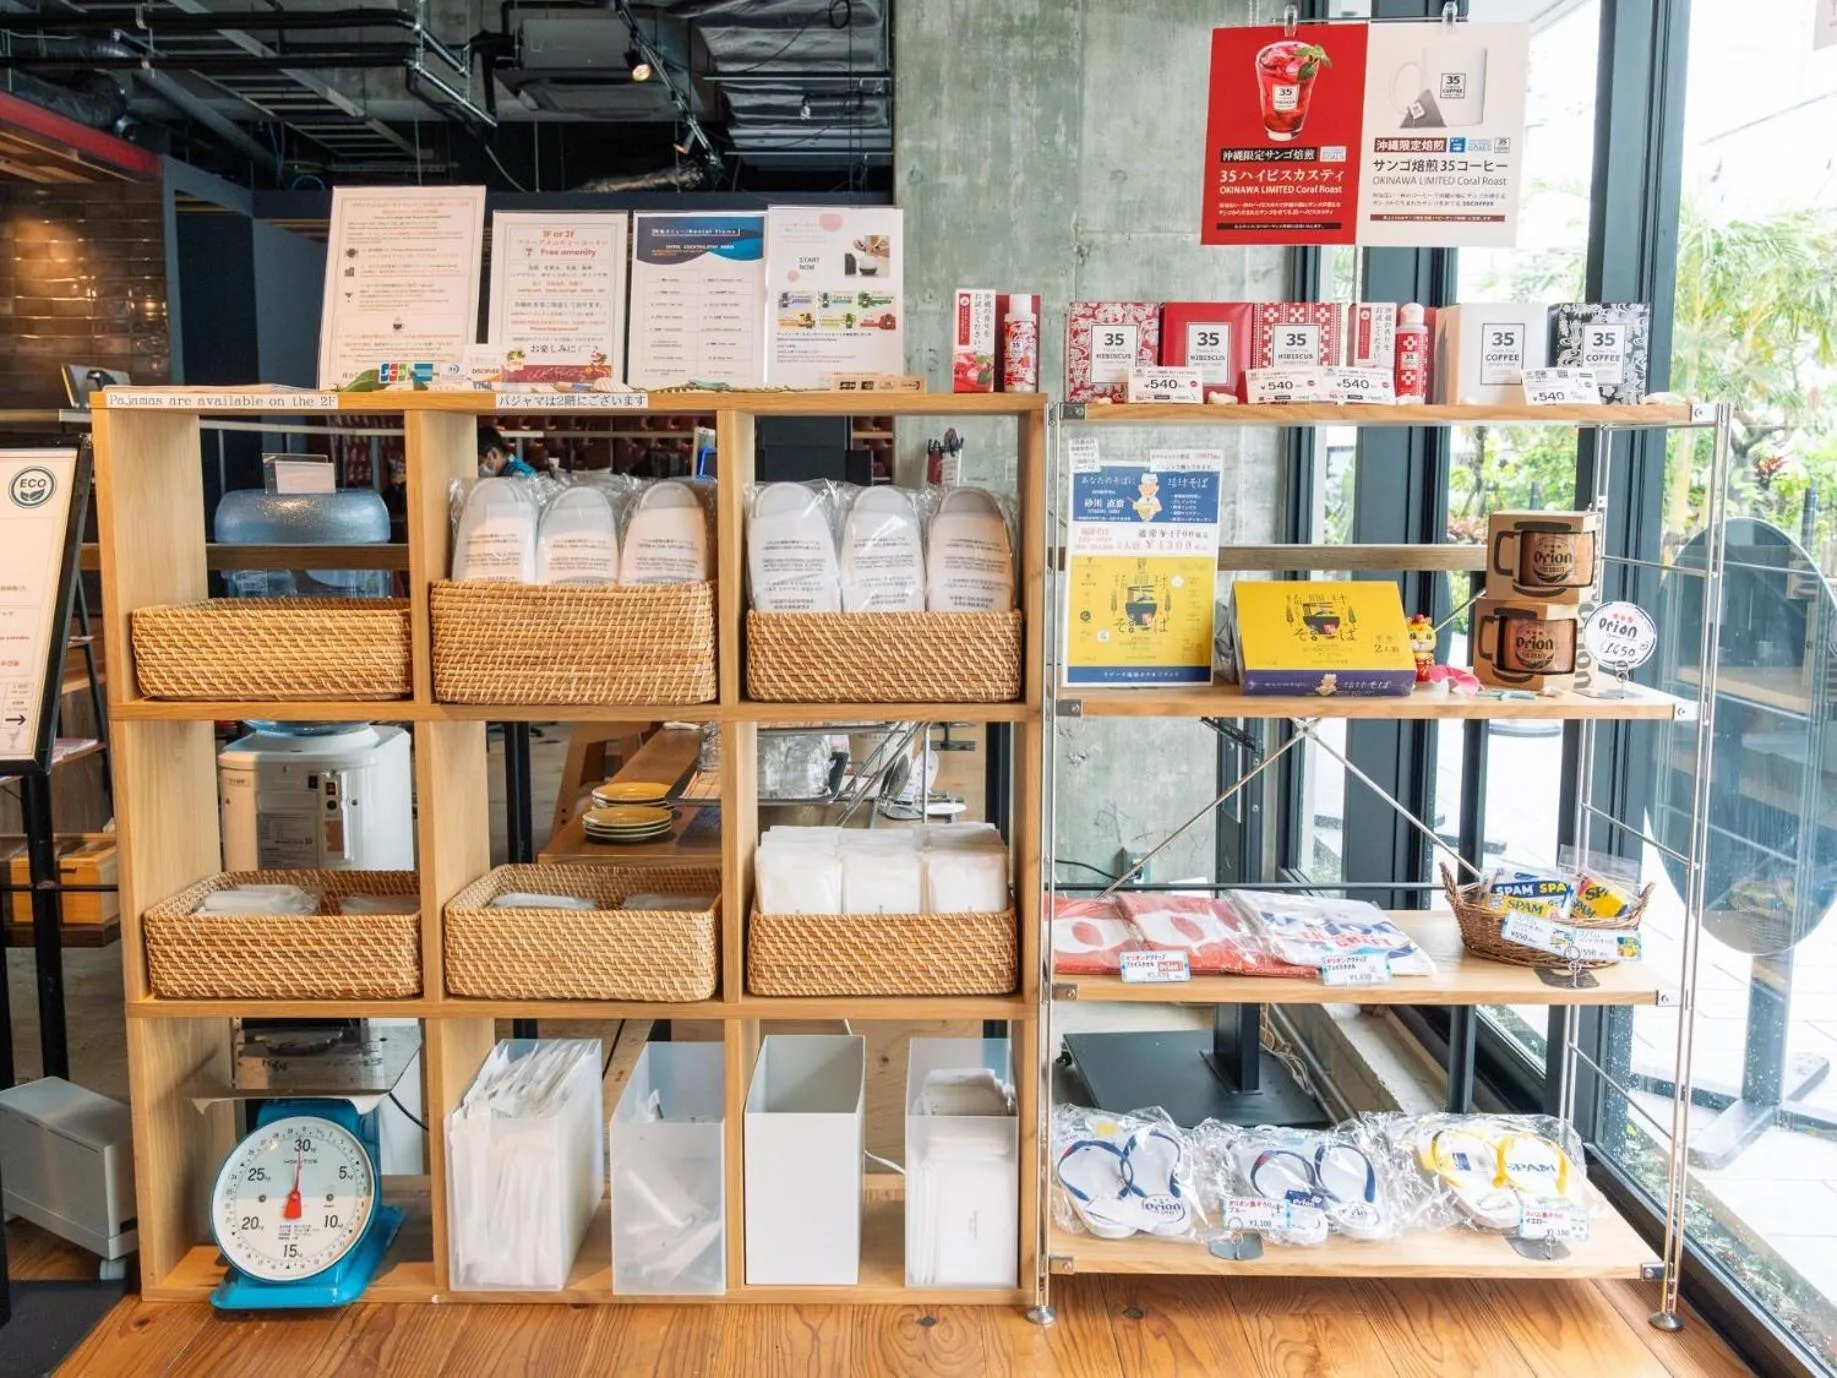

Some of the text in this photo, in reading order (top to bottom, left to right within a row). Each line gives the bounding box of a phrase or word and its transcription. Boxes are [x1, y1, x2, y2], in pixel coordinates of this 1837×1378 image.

[1446, 76, 1460, 85] 35
[1279, 87, 1292, 96] 35
[1376, 139, 1445, 151] 沖縄限定焙煎
[1223, 149, 1315, 161] 沖縄限定サンゴ焙煎
[1373, 159, 1508, 173] サンゴ焙煎35コーヒー
[1373, 176, 1506, 185] OKINAWA LIMITED Coral Roast
[1219, 184, 1342, 195] OKINAWA LIMITED Coral Roast
[1104, 333, 1125, 346] 35
[1197, 332, 1220, 346] 35
[1285, 333, 1306, 346] 35
[1491, 332, 1514, 346] 35
[1592, 332, 1616, 346] 35
[1485, 353, 1519, 361] COFFEE
[1585, 354, 1621, 362] COFFEE
[1144, 379, 1178, 389] ¥540
[1261, 380, 1293, 390] ¥540
[1336, 379, 1370, 389] ¥540
[109, 395, 335, 406] Pajamas are available on the 2F
[499, 394, 646, 407] パジャマは2階にございます
[1532, 391, 1565, 402] ¥540
[20, 479, 47, 488] ECO
[1496, 883, 1567, 896] SPAM SPA
[1507, 899, 1544, 914] SPAM
